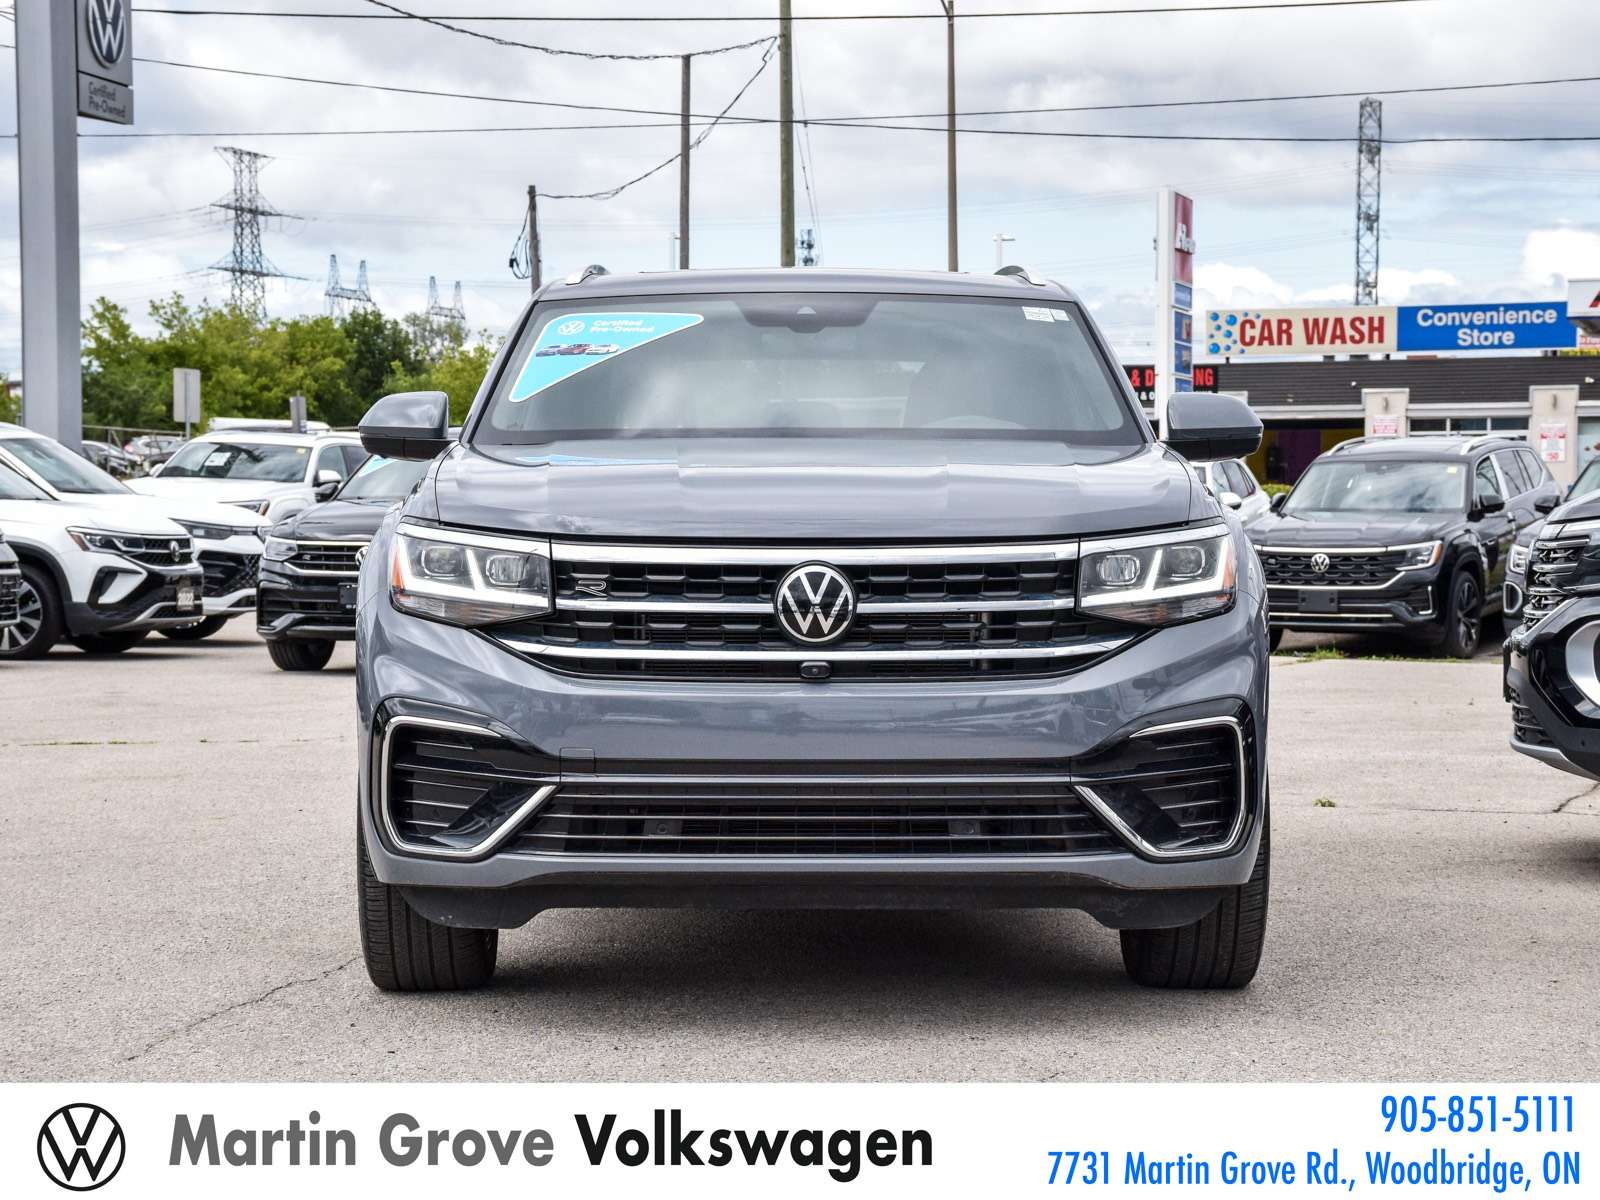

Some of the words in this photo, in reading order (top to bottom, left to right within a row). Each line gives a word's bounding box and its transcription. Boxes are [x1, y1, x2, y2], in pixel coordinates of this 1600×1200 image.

[88, 81, 116, 101] Certified
[88, 95, 126, 118] Pre-Owned
[593, 319, 643, 327] Certified
[1416, 306, 1558, 327] Convenience
[1239, 317, 1293, 347] CAR
[1302, 315, 1385, 345] WASH
[1457, 328, 1515, 346] Store
